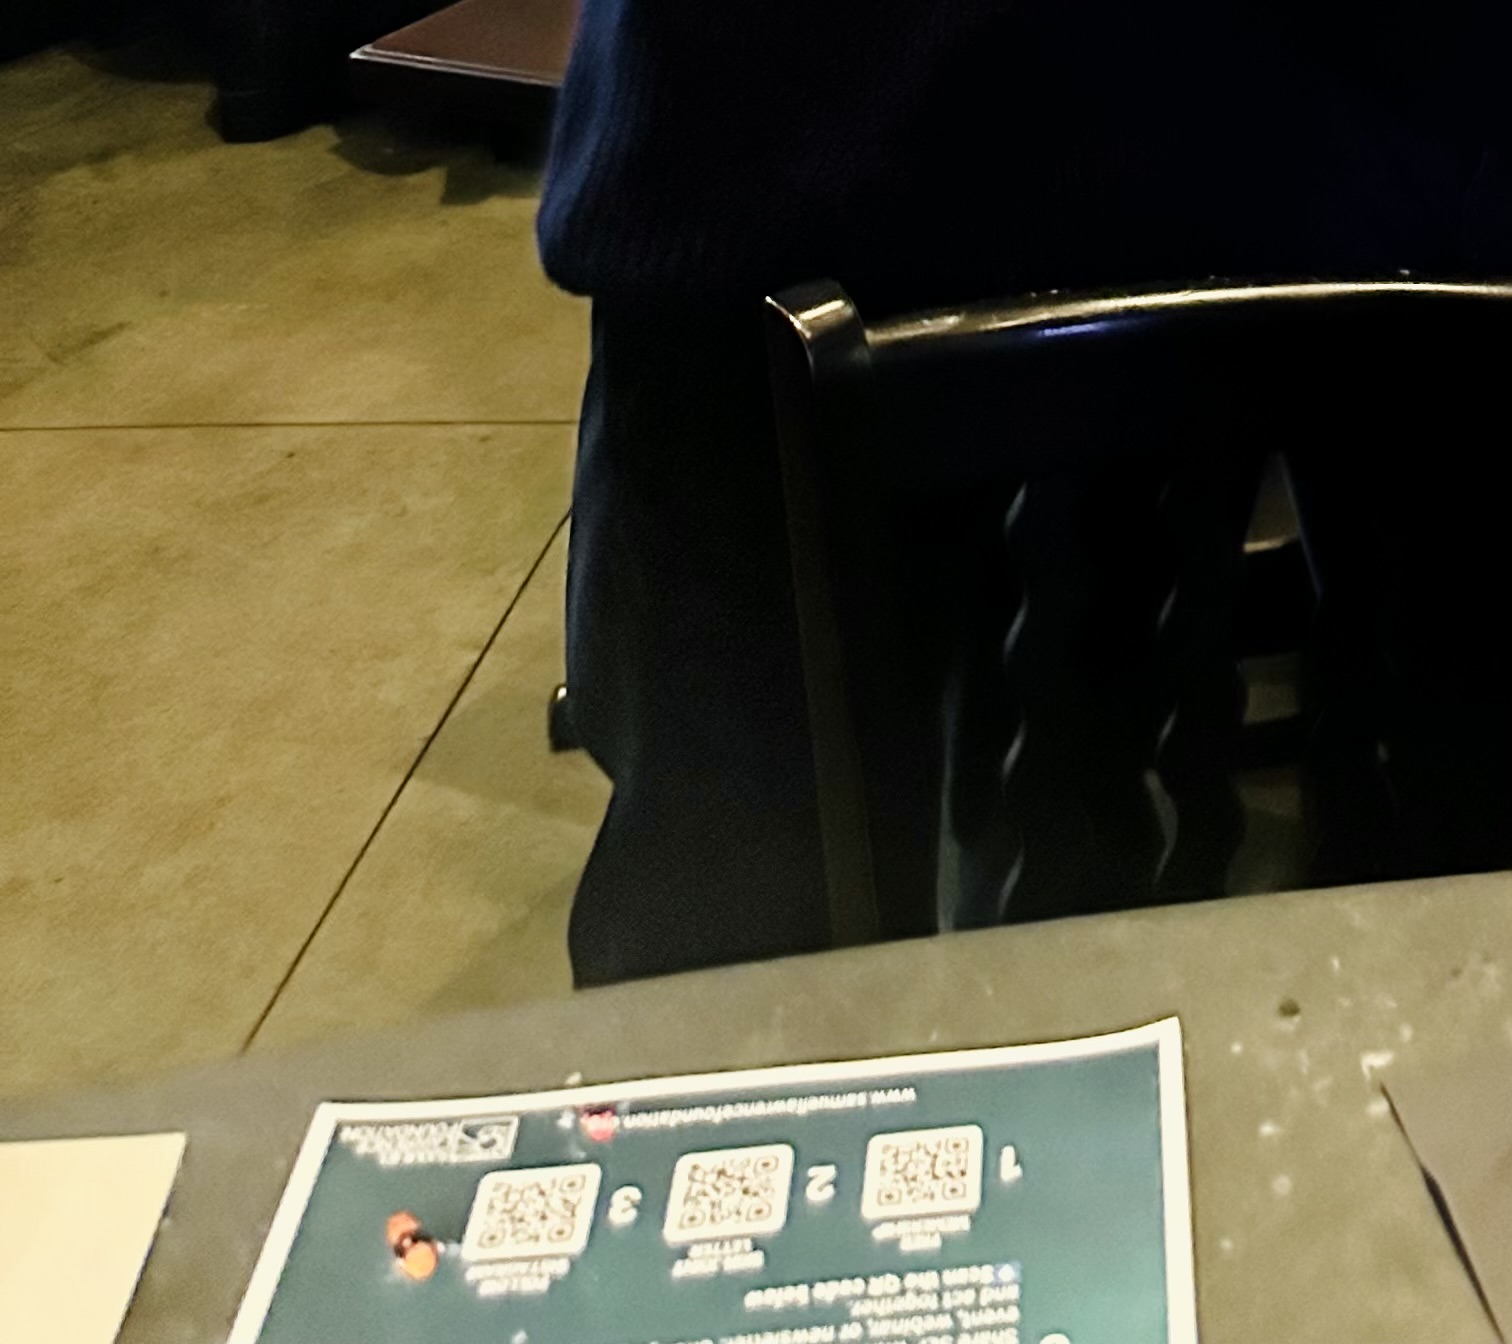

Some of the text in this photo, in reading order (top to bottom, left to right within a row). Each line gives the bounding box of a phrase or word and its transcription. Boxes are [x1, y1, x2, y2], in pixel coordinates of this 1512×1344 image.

[804, 1163, 838, 1204] 2
[998, 1144, 1024, 1184] 1
[607, 1184, 643, 1227] 3
[743, 1284, 810, 1311] below
